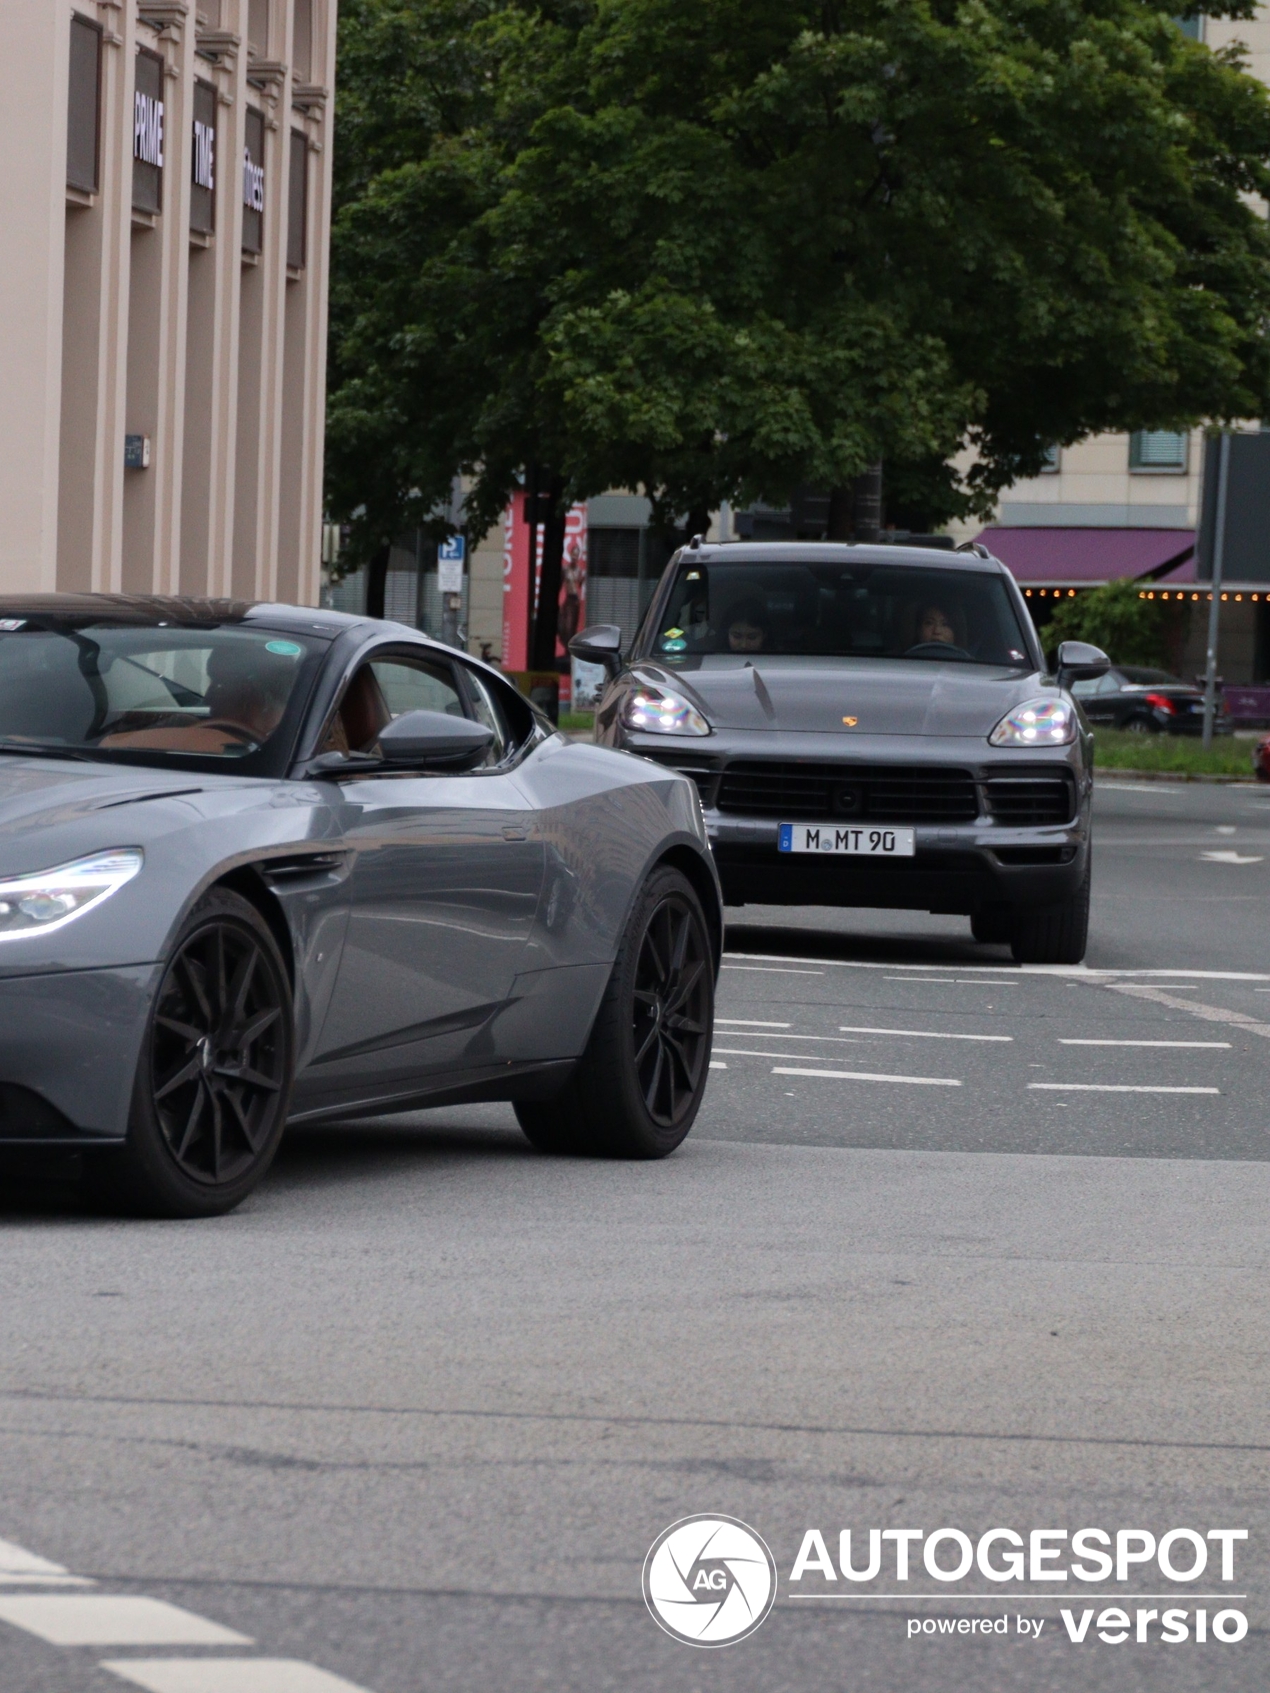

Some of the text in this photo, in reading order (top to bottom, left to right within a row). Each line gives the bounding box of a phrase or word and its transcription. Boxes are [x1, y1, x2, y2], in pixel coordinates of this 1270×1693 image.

[134, 91, 163, 168] PRIME
[806, 828, 820, 848] M
[835, 830, 865, 851] MT
[869, 830, 895, 852] 90
